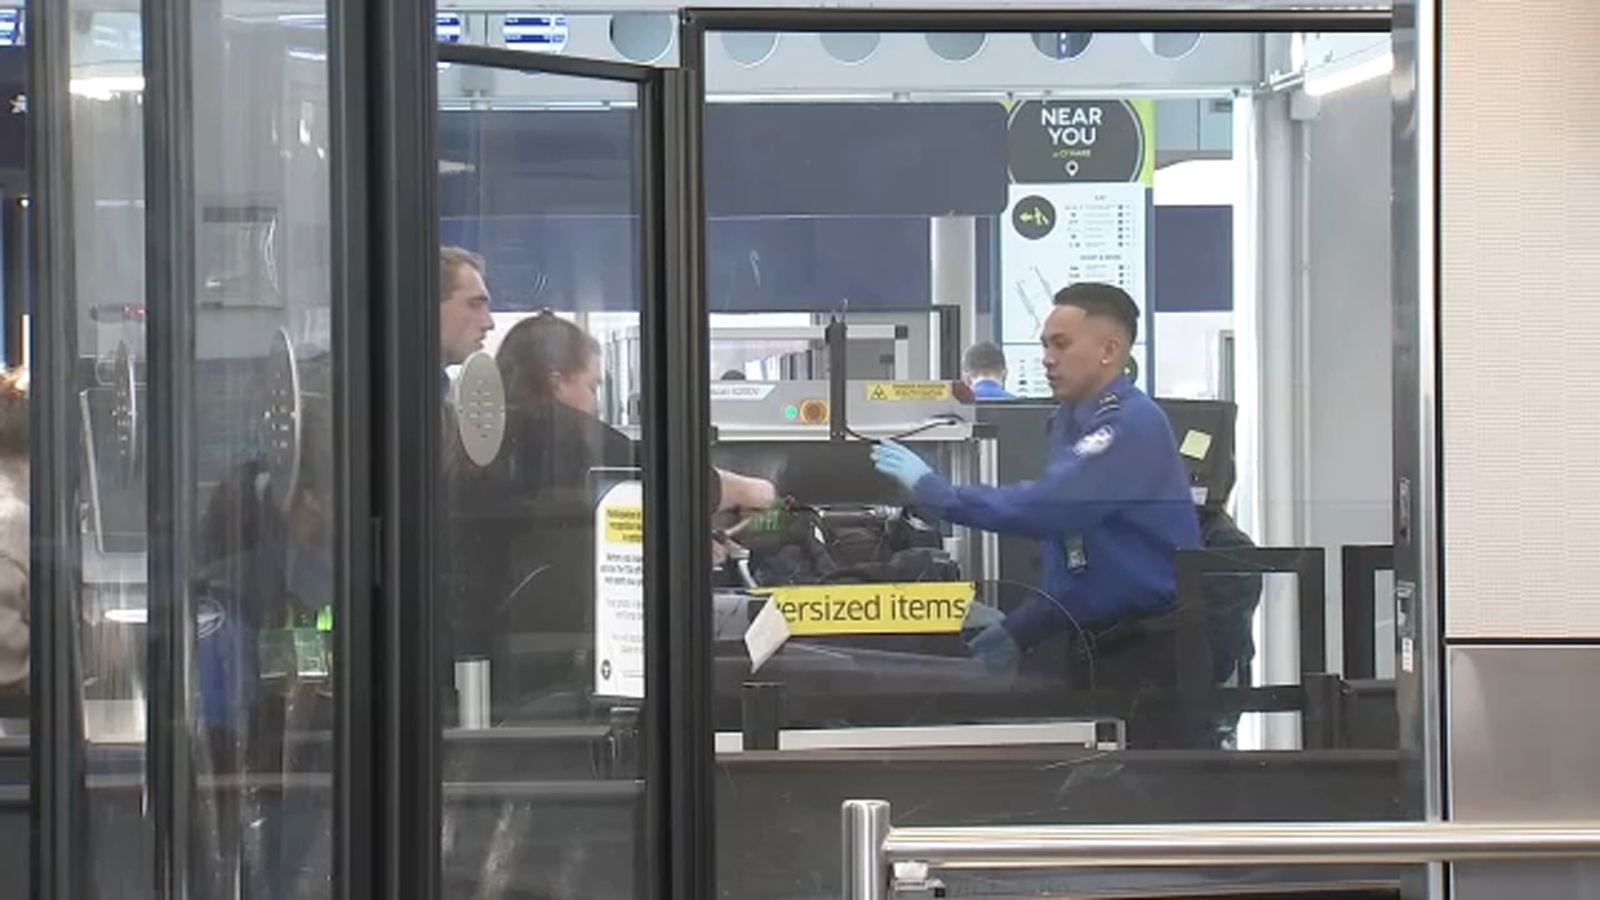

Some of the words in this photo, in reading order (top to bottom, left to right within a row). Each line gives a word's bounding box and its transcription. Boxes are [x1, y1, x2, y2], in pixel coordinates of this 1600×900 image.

[1041, 107, 1102, 125] NEAR
[1048, 127, 1096, 145] YOU
[776, 594, 881, 623] ersized
[891, 594, 966, 620] items
